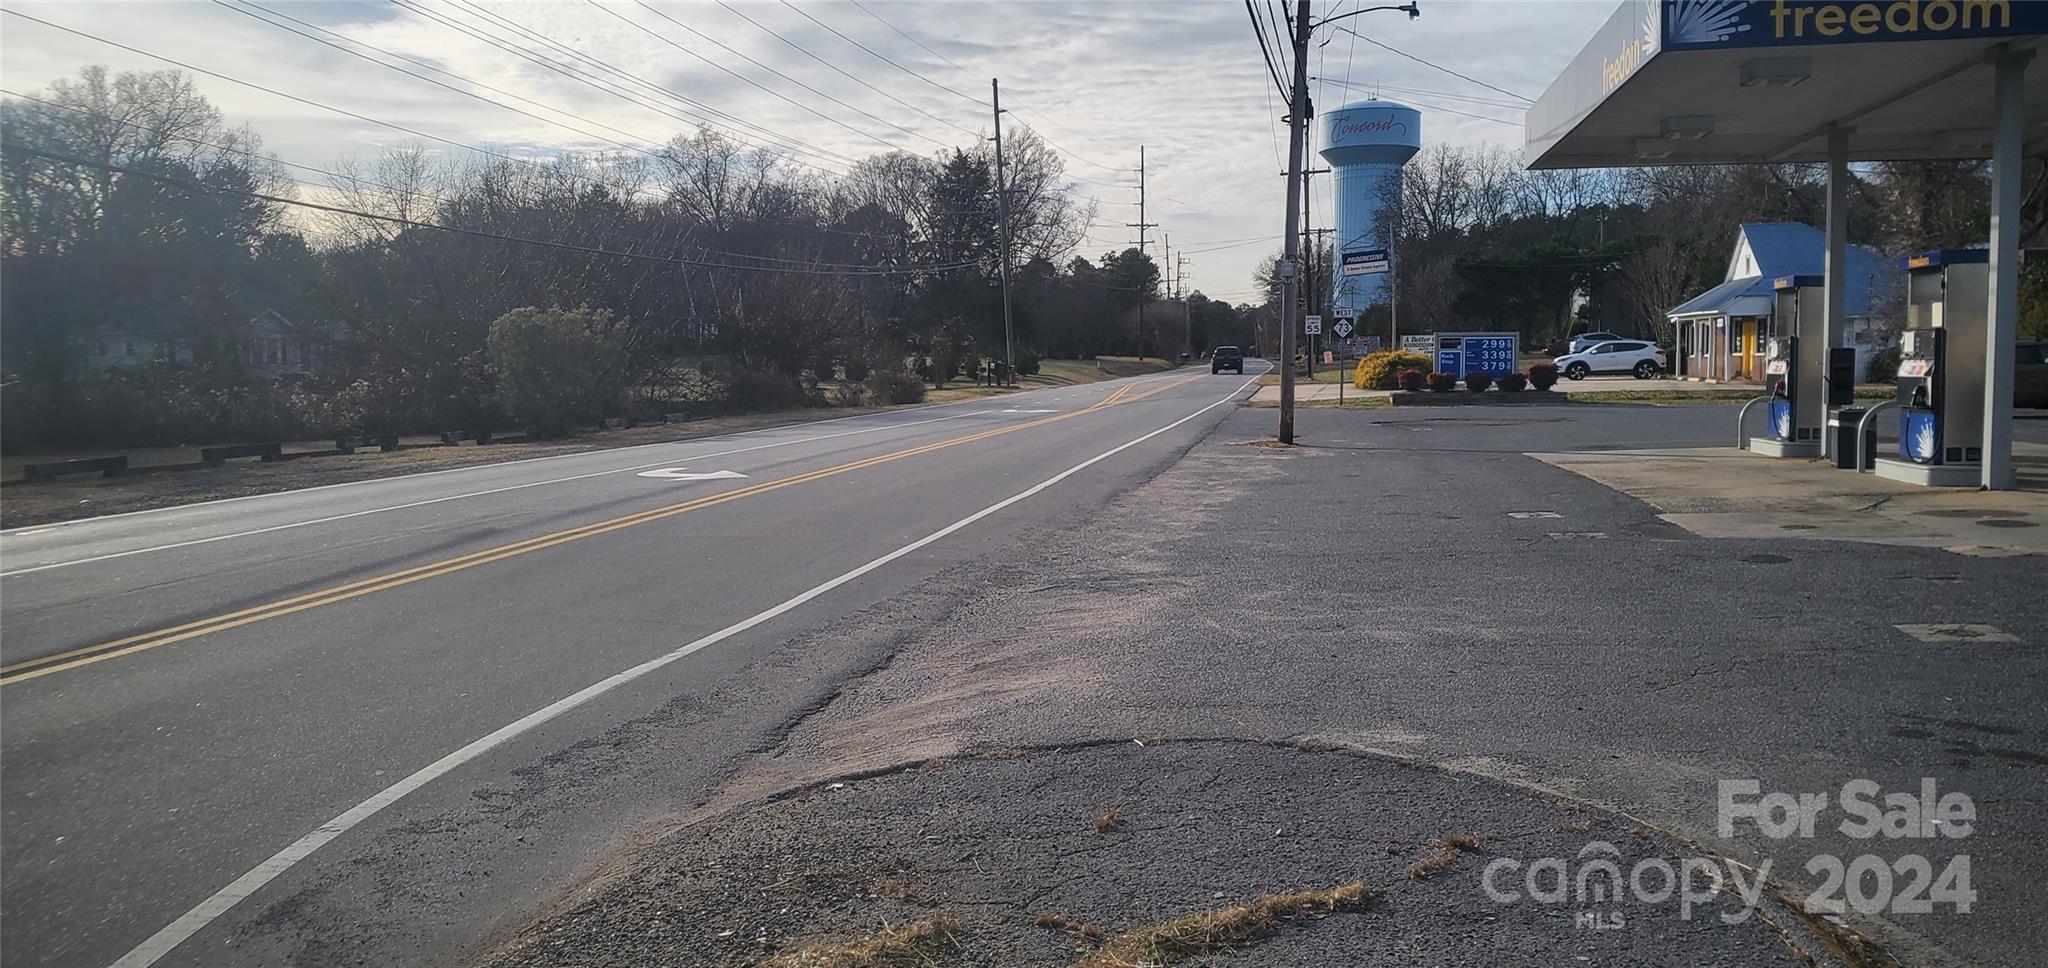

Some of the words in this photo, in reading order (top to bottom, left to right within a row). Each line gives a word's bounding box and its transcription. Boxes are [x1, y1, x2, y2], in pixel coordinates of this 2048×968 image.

[1770, 0, 2010, 38] freedom
[1603, 38, 1640, 95] freedom
[1329, 112, 1407, 143] Concord
[1346, 253, 1384, 263] PROGRESSIVE
[1338, 323, 1349, 333] 73
[1482, 340, 1506, 348] 299
[1482, 350, 1506, 359] 339
[1482, 361, 1506, 370] 379
